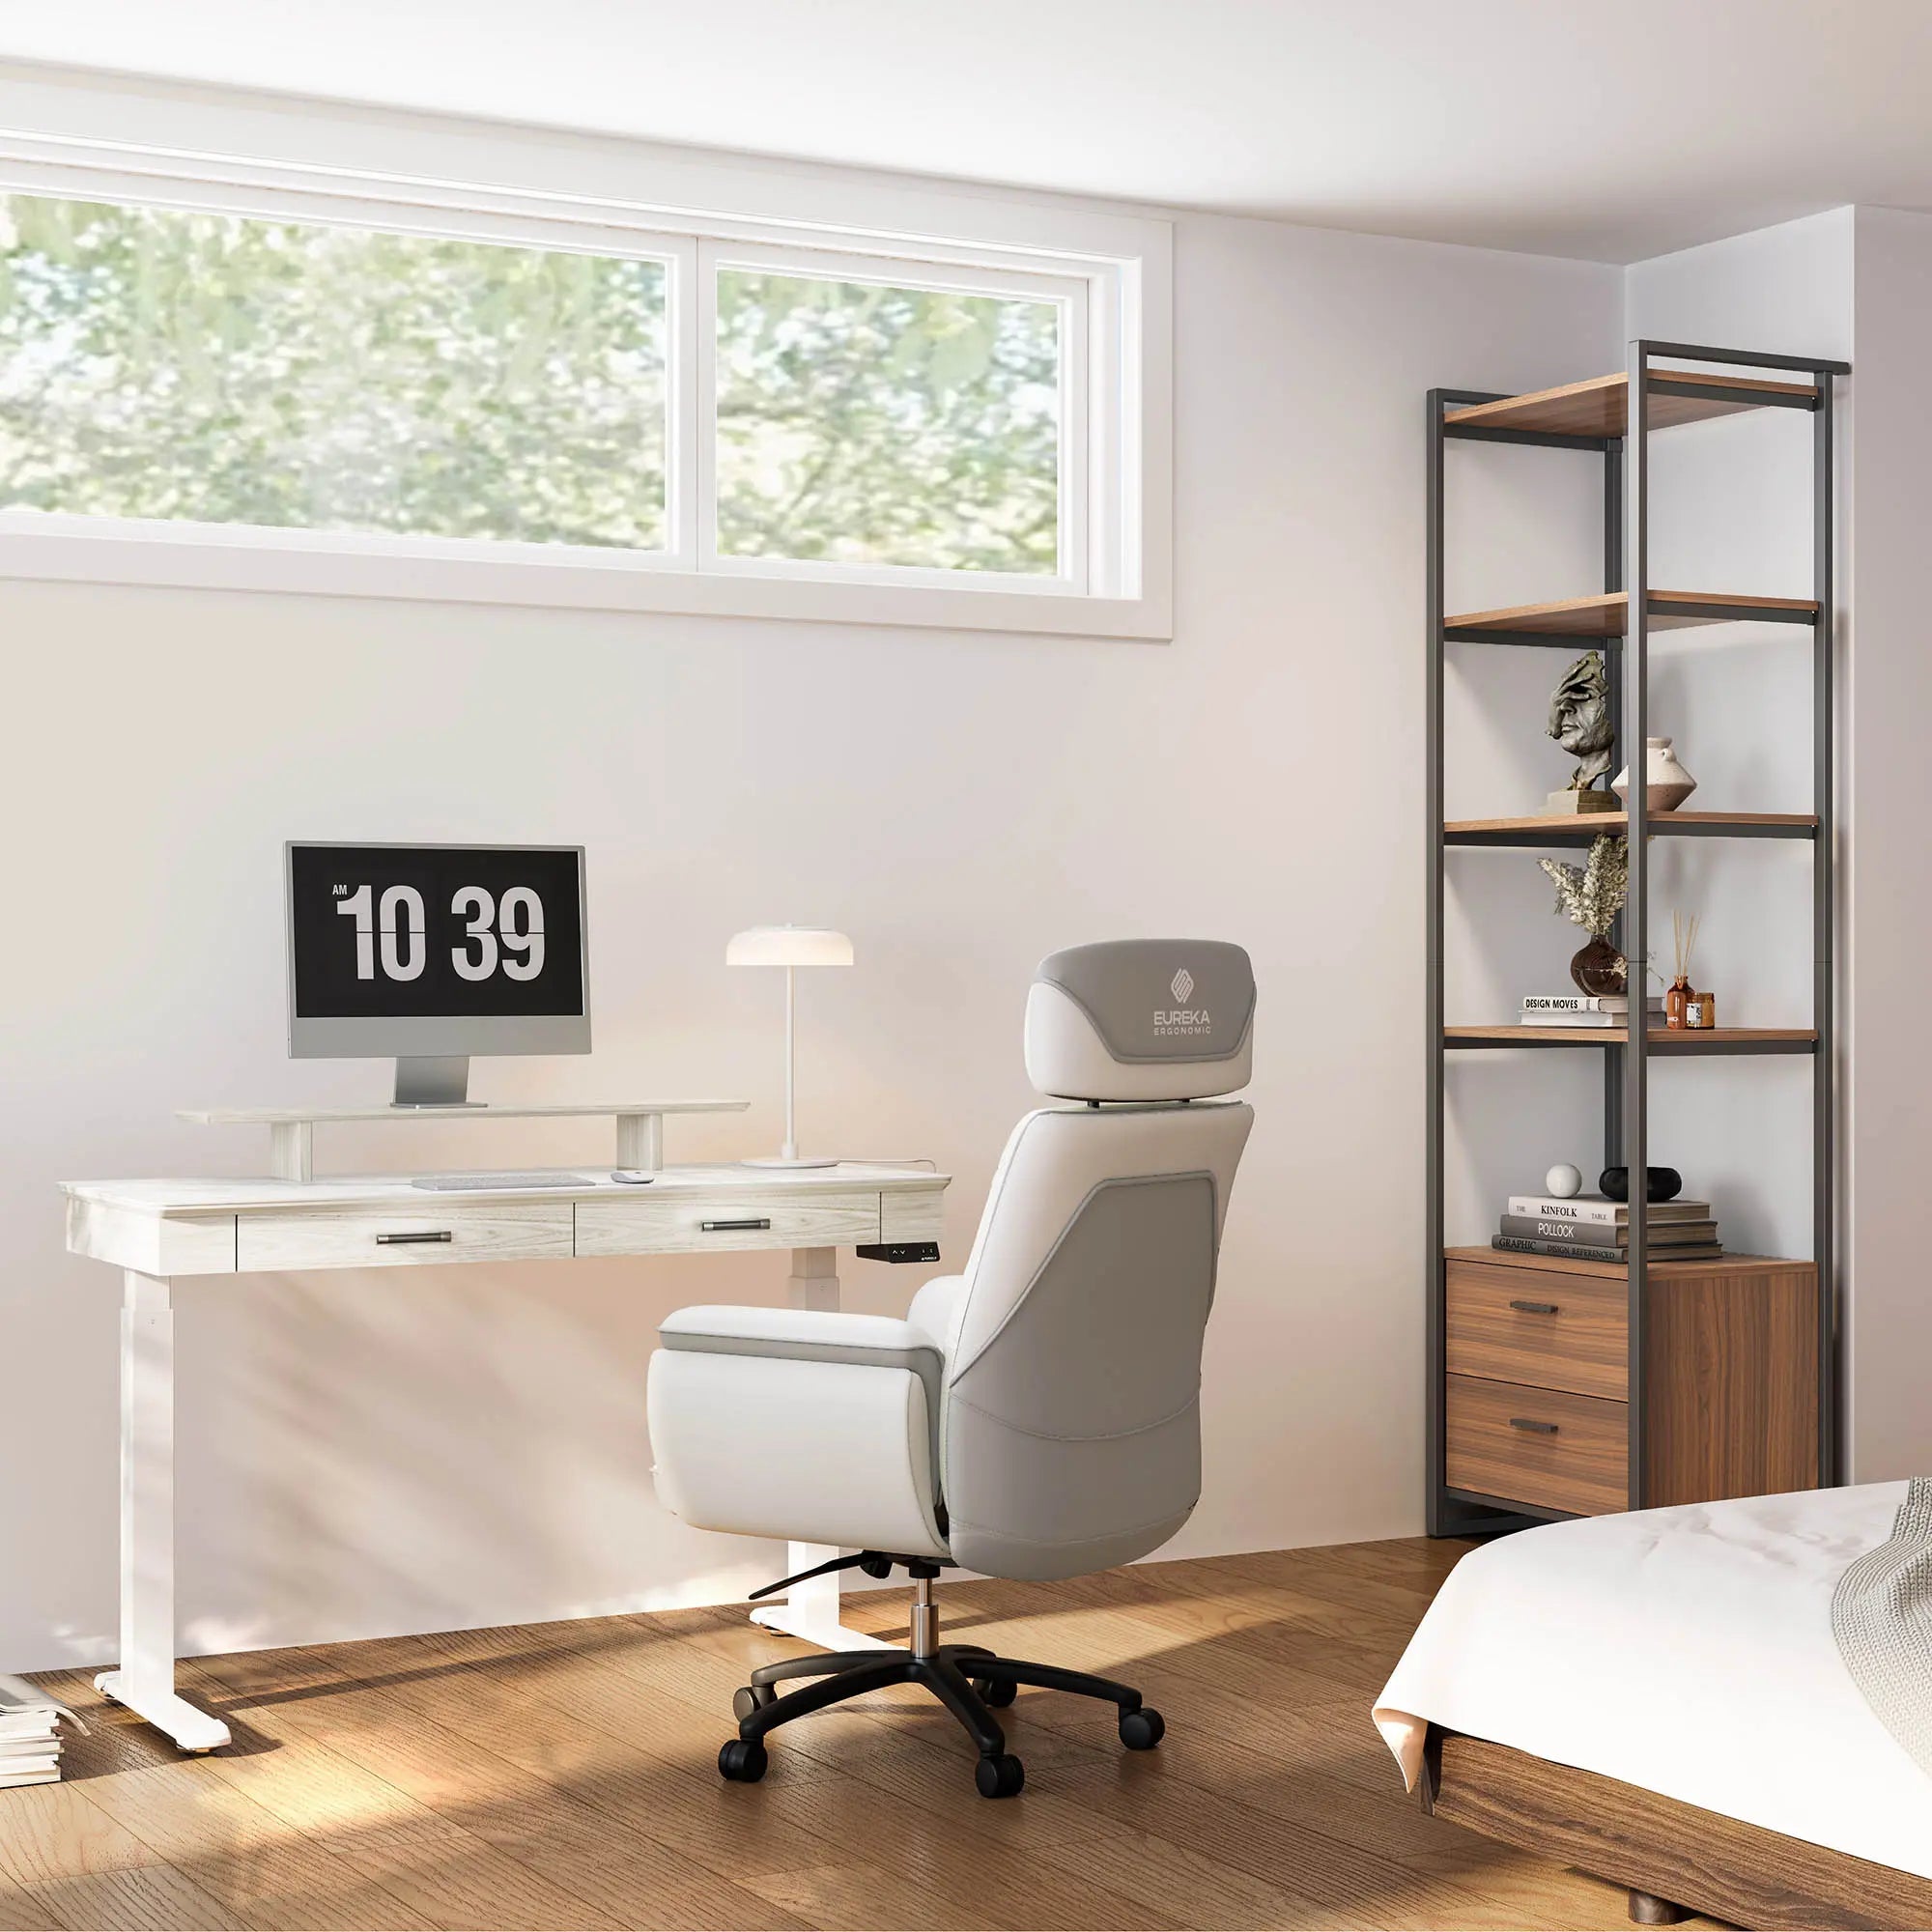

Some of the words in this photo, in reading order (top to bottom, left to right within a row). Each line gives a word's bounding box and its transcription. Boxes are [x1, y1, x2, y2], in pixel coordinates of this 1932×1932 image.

[332, 884, 348, 895] AM
[336, 885, 426, 981] 10
[451, 886, 545, 981] 39
[1525, 999, 1550, 1009] DESIGN
[1552, 999, 1578, 1009] MOVES
[1153, 1009, 1210, 1025] EUREKA
[1153, 1026, 1211, 1036] ERGONOMIC
[1541, 1205, 1577, 1218] KINFOLK
[1538, 1222, 1575, 1237] POLLOCK
[1498, 1237, 1537, 1251] GRAPHIC
[1572, 1247, 1615, 1260] REFERENCED
